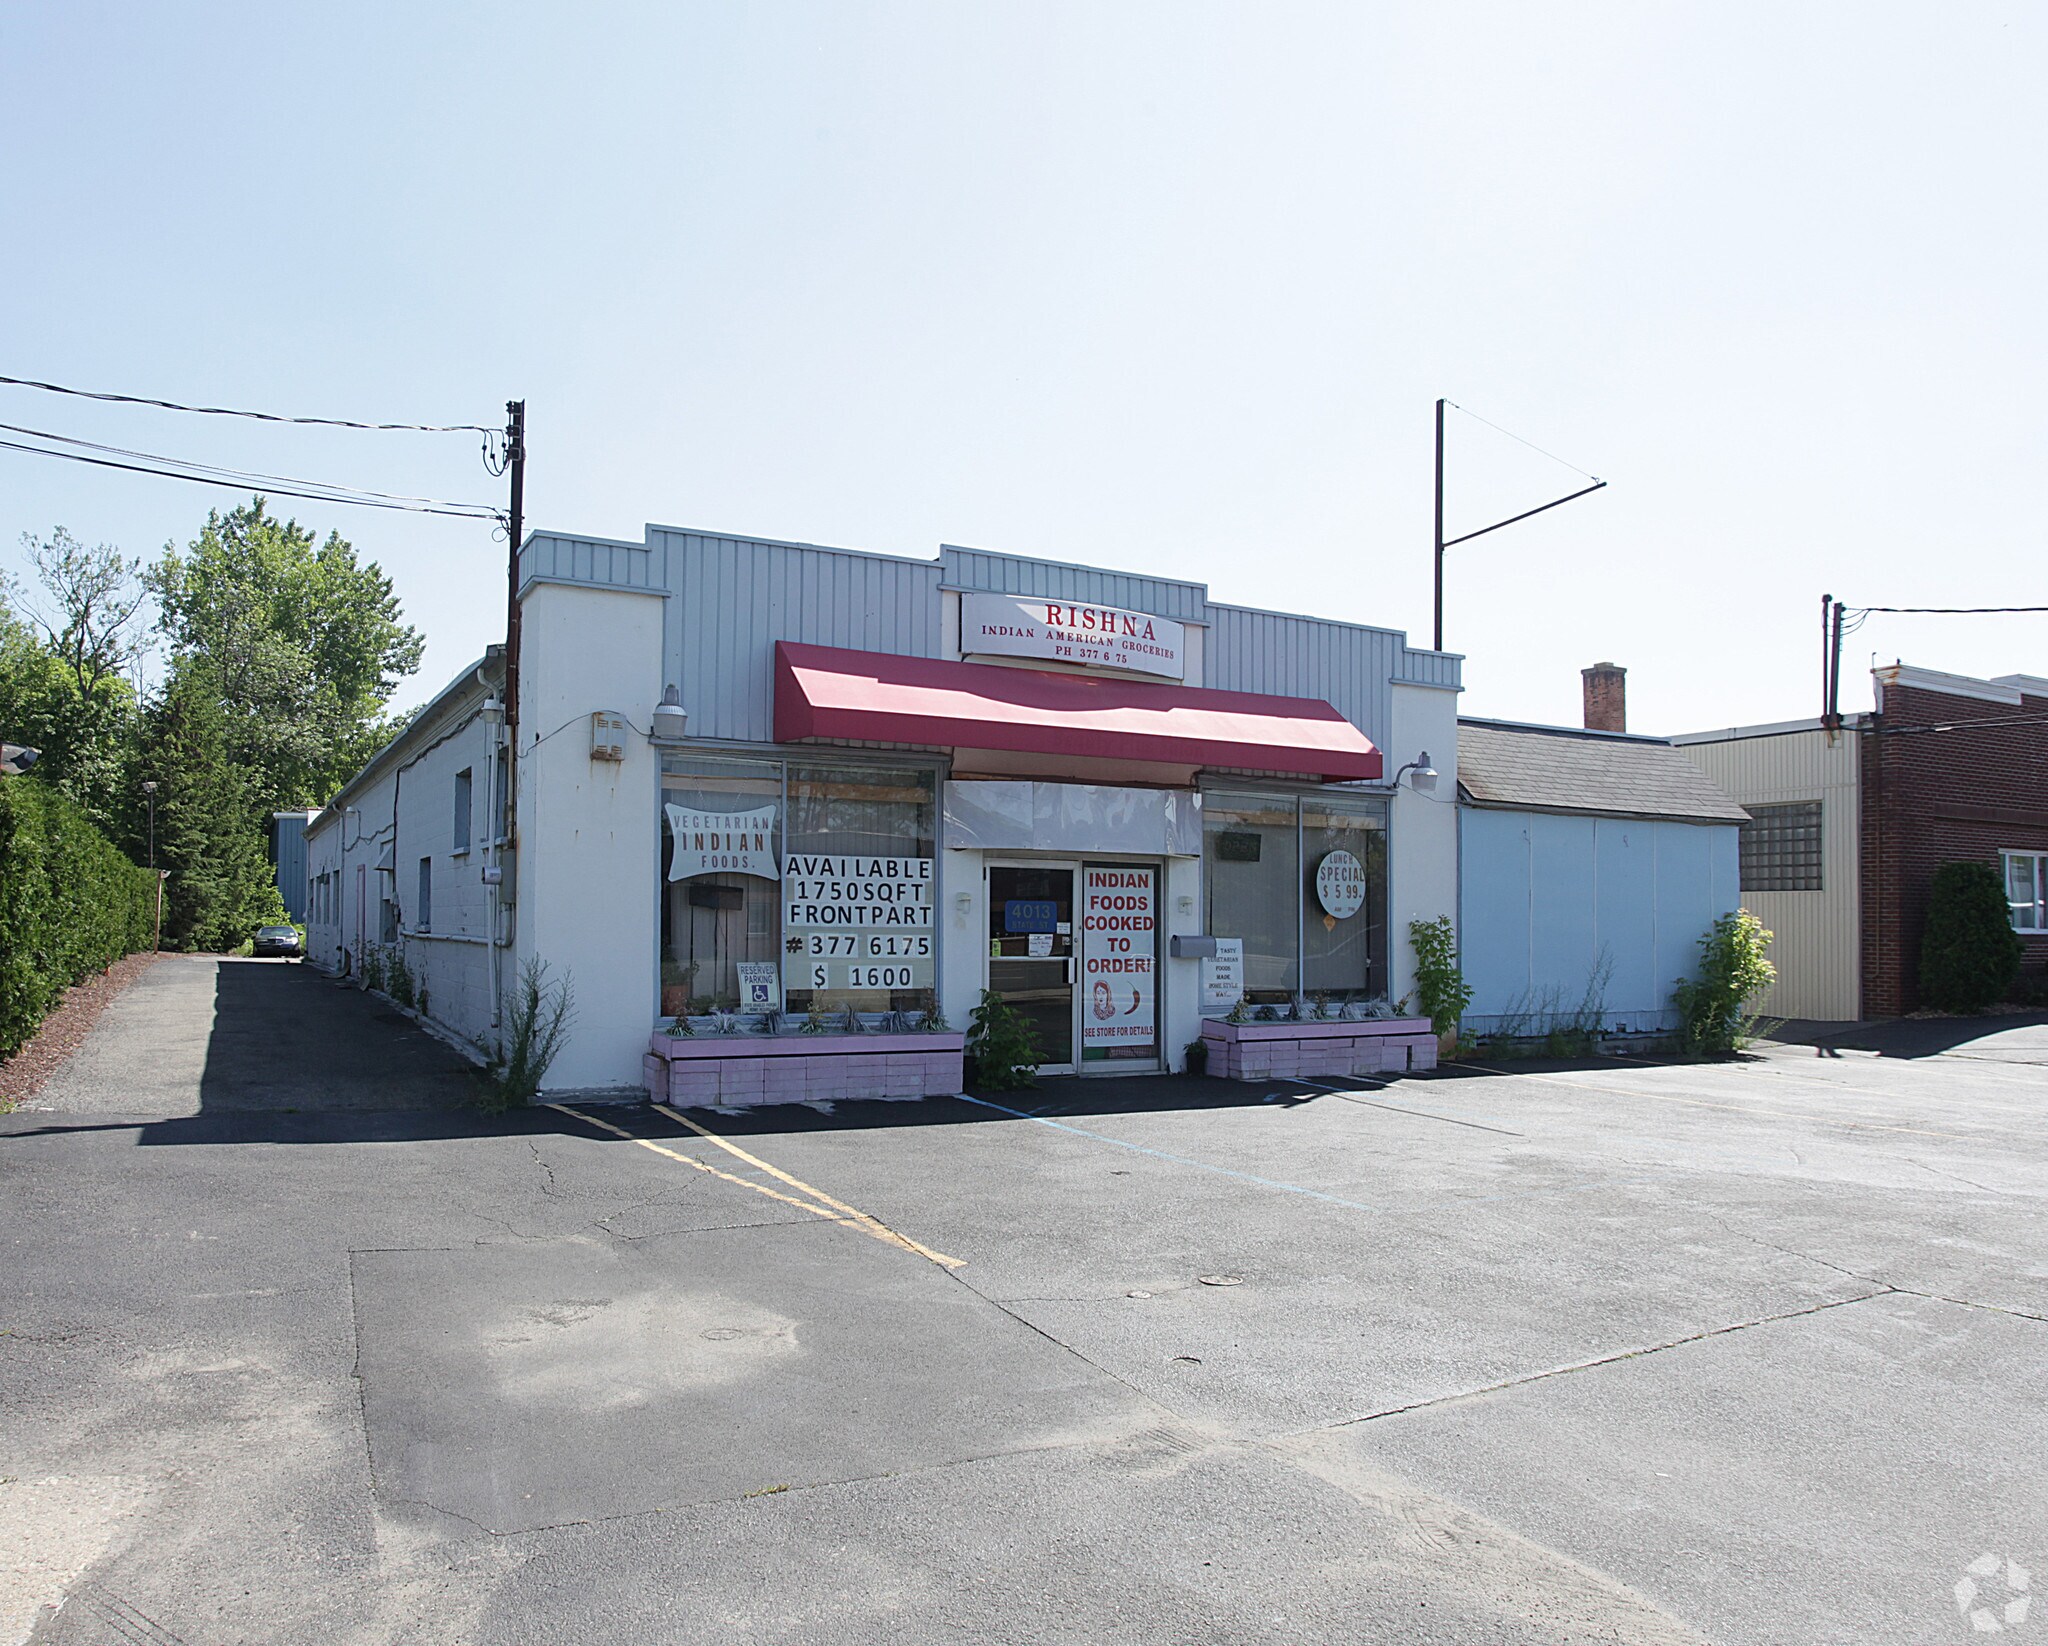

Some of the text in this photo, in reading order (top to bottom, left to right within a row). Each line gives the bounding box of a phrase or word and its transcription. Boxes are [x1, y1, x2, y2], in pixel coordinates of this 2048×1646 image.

[1045, 603, 1156, 641] RISHNA
[981, 625, 1174, 660] INDIAN AMERICAN GROCERIES
[1055, 645, 1072, 656] PH
[1079, 649, 1099, 660] 377
[673, 815, 769, 830] VEGETARIAN
[682, 832, 764, 851] INDIAN
[701, 855, 755, 868] FOODS.
[1329, 854, 1354, 865] LUNCH
[786, 856, 930, 879] AVAILABLE
[1320, 866, 1364, 882] SPECIAL
[1089, 872, 1149, 888] INDIAN
[1090, 895, 1148, 911] FOODS
[1012, 904, 1051, 919] 4013
[1084, 915, 1154, 931] COOKED
[811, 935, 856, 955] 377
[870, 936, 929, 955] 6175
[1107, 937, 1131, 952] TO
[740, 966, 775, 975] RESERVED
[1087, 958, 1151, 973] ORDER!
[744, 975, 773, 984] PARKING
[852, 967, 911, 987] 1600
[1085, 1025, 1153, 1037] SEE STORE FOR DETAILS
